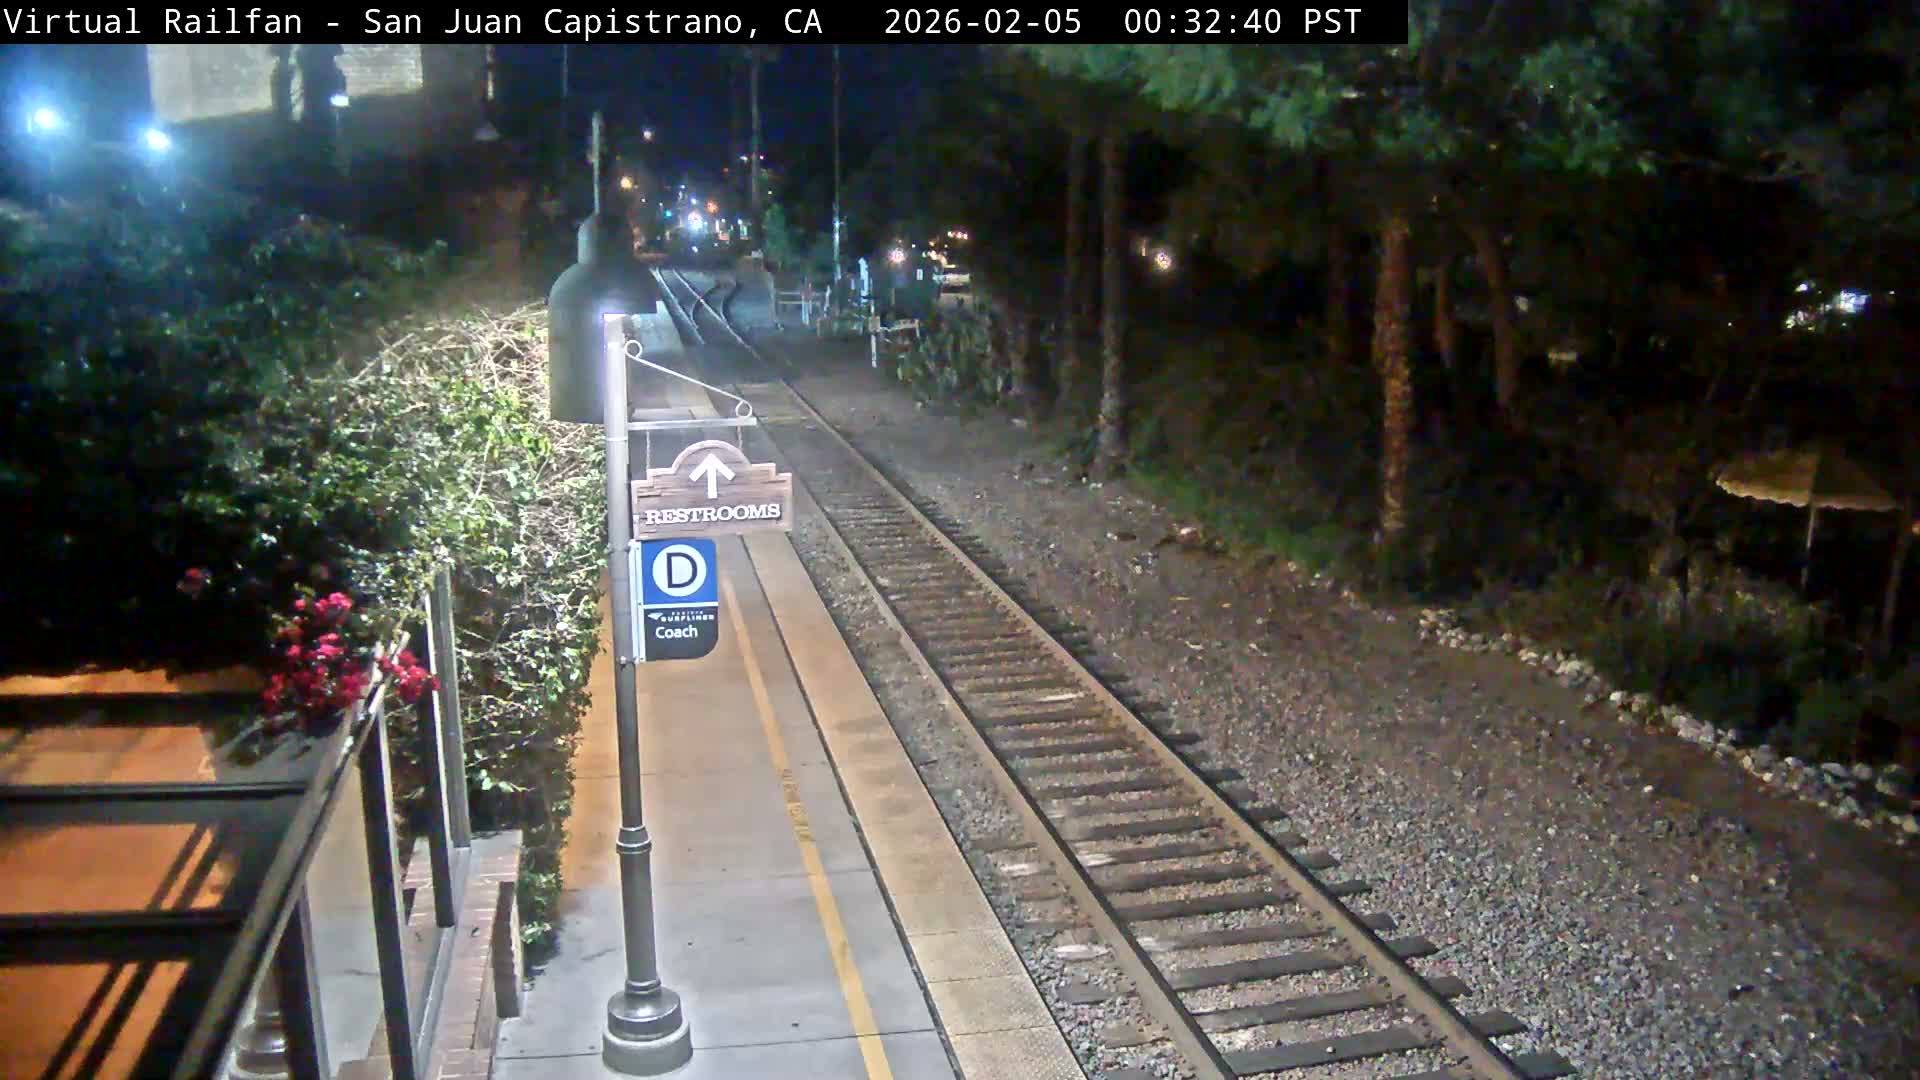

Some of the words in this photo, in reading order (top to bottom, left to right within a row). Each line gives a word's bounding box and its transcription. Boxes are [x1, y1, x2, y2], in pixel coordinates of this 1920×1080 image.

[645, 503, 781, 525] RESTROOMS
[666, 552, 698, 589] D
[655, 624, 698, 639] Coach
